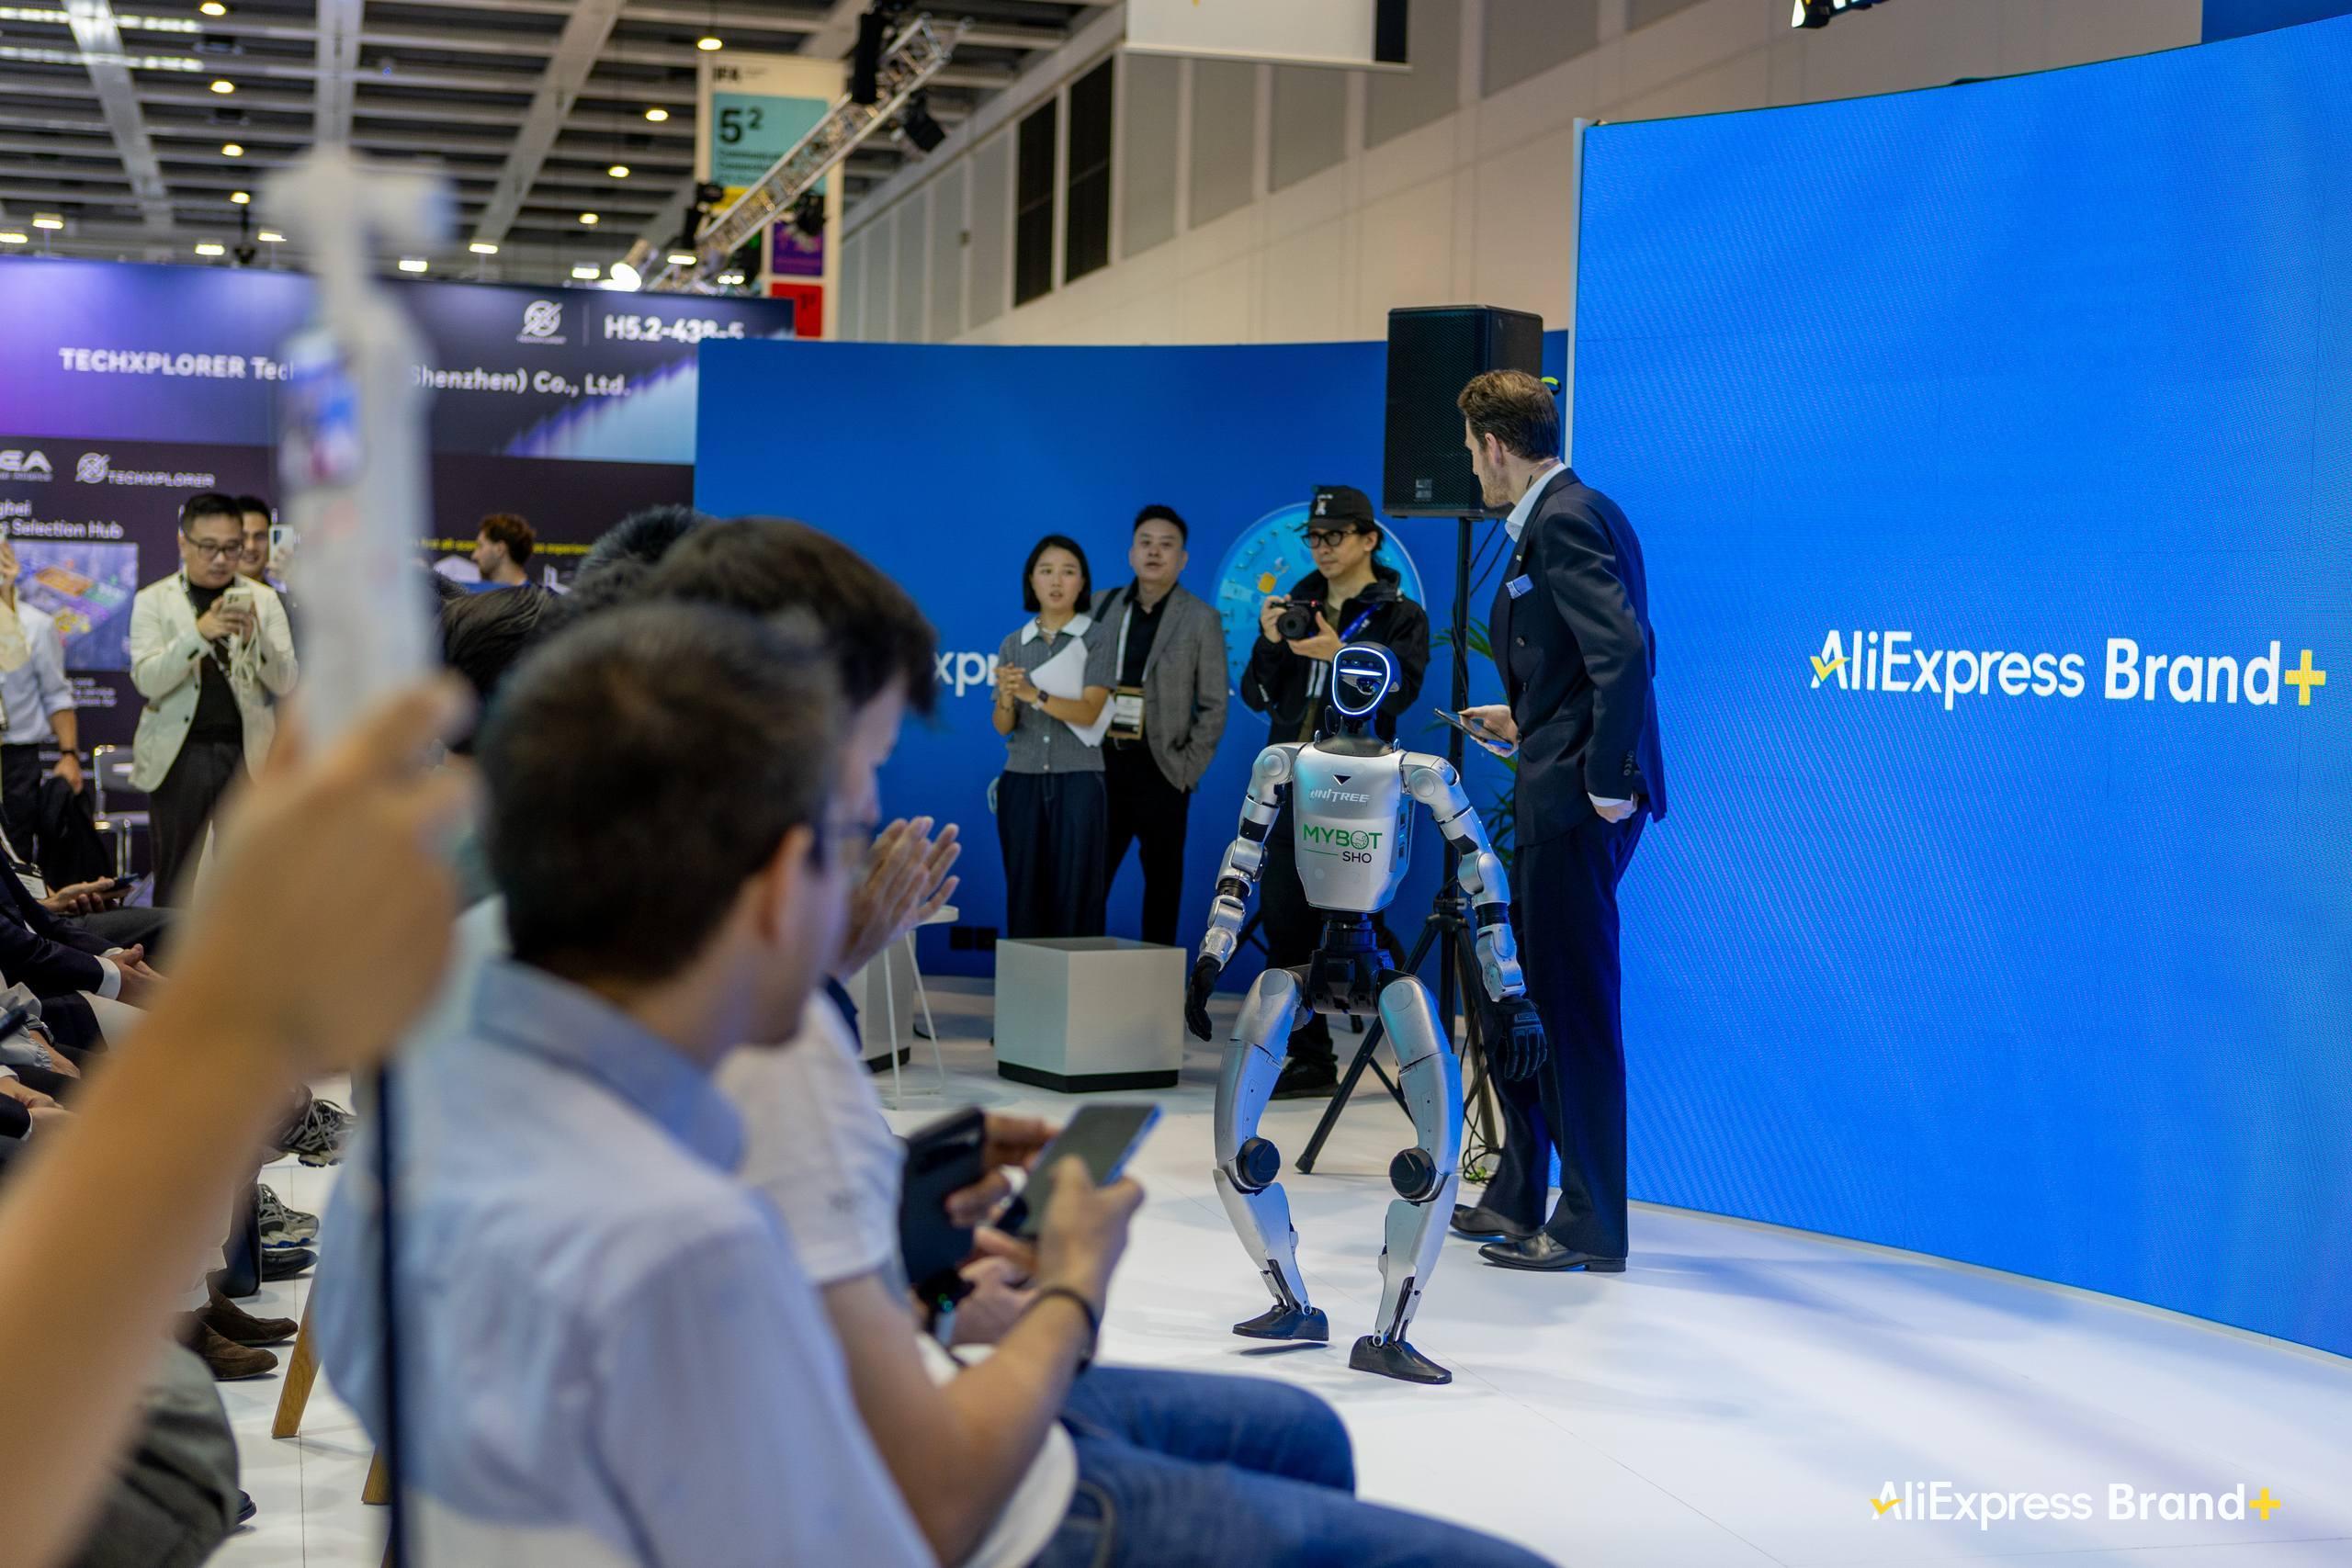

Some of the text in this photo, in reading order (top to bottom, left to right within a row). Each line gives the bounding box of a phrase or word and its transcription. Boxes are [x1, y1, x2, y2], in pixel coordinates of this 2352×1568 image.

[59, 347, 246, 378] TECHXPLORER
[584, 373, 631, 396] Ltd.
[107, 469, 216, 489] TECHXPLORER
[11, 518, 86, 538] Selection
[88, 520, 125, 540] Hub
[1810, 629, 2086, 711] AliExpress
[1303, 823, 1383, 850] MYBOT
[1342, 851, 1373, 863] SHO
